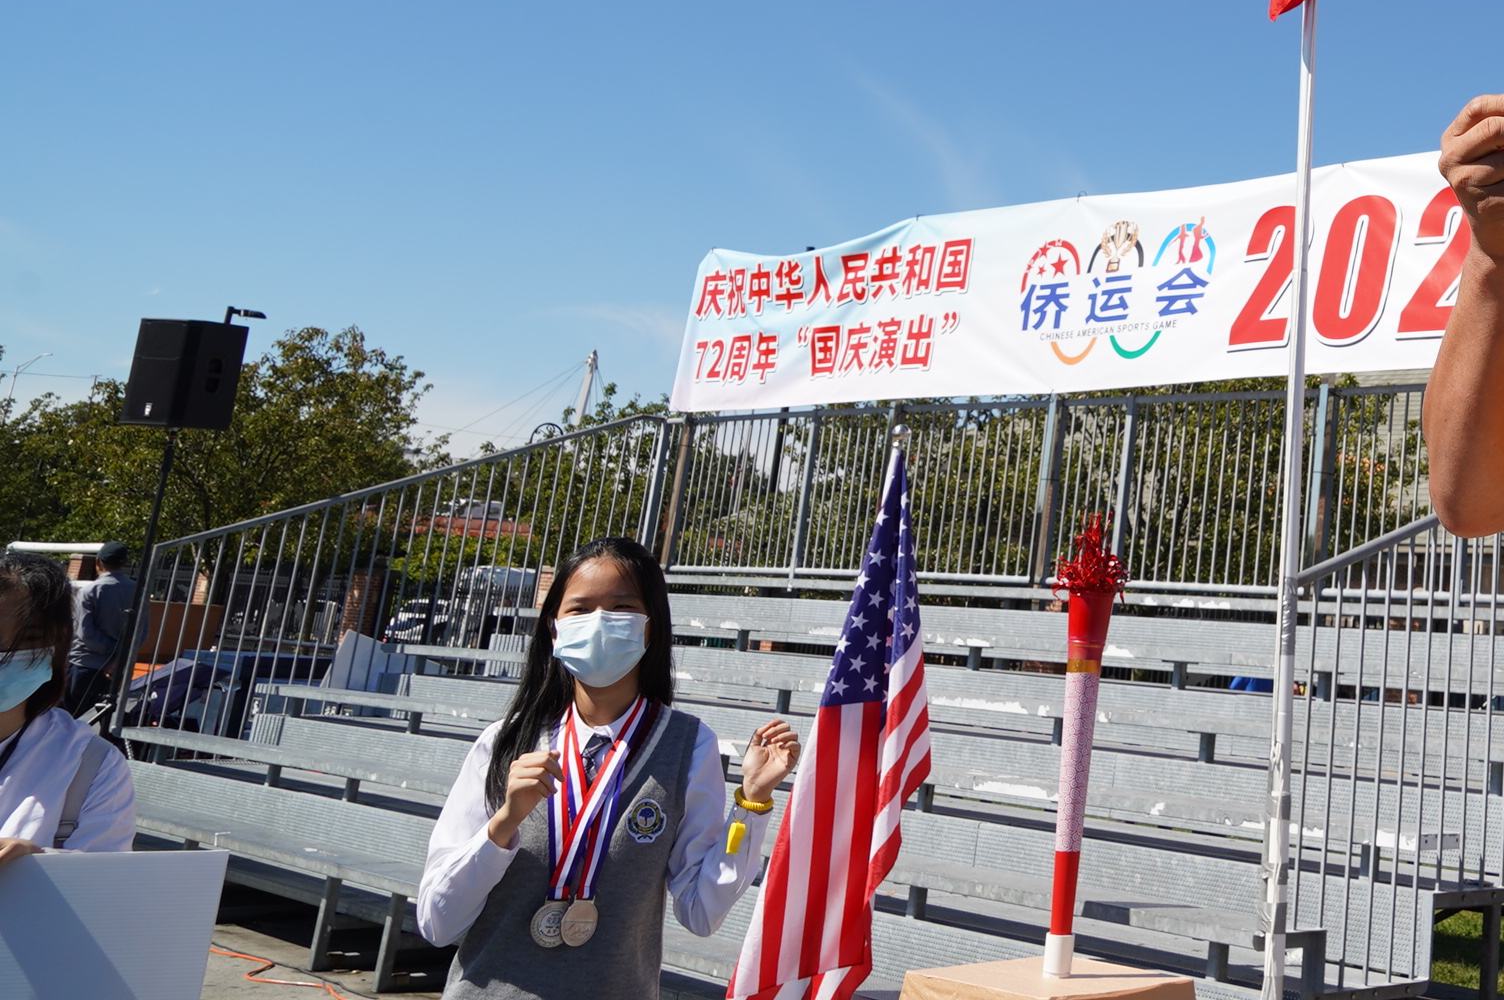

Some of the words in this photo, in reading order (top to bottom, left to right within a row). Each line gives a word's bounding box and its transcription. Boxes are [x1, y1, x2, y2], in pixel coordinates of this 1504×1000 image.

[694, 236, 975, 321] 庆祝中华人民共和国
[1020, 267, 1210, 332] 侨运会
[1040, 330, 1074, 341] CHINESE
[1077, 326, 1115, 338] AMERICAN
[1117, 323, 1150, 333] SPORTS
[1153, 319, 1178, 330] GAME
